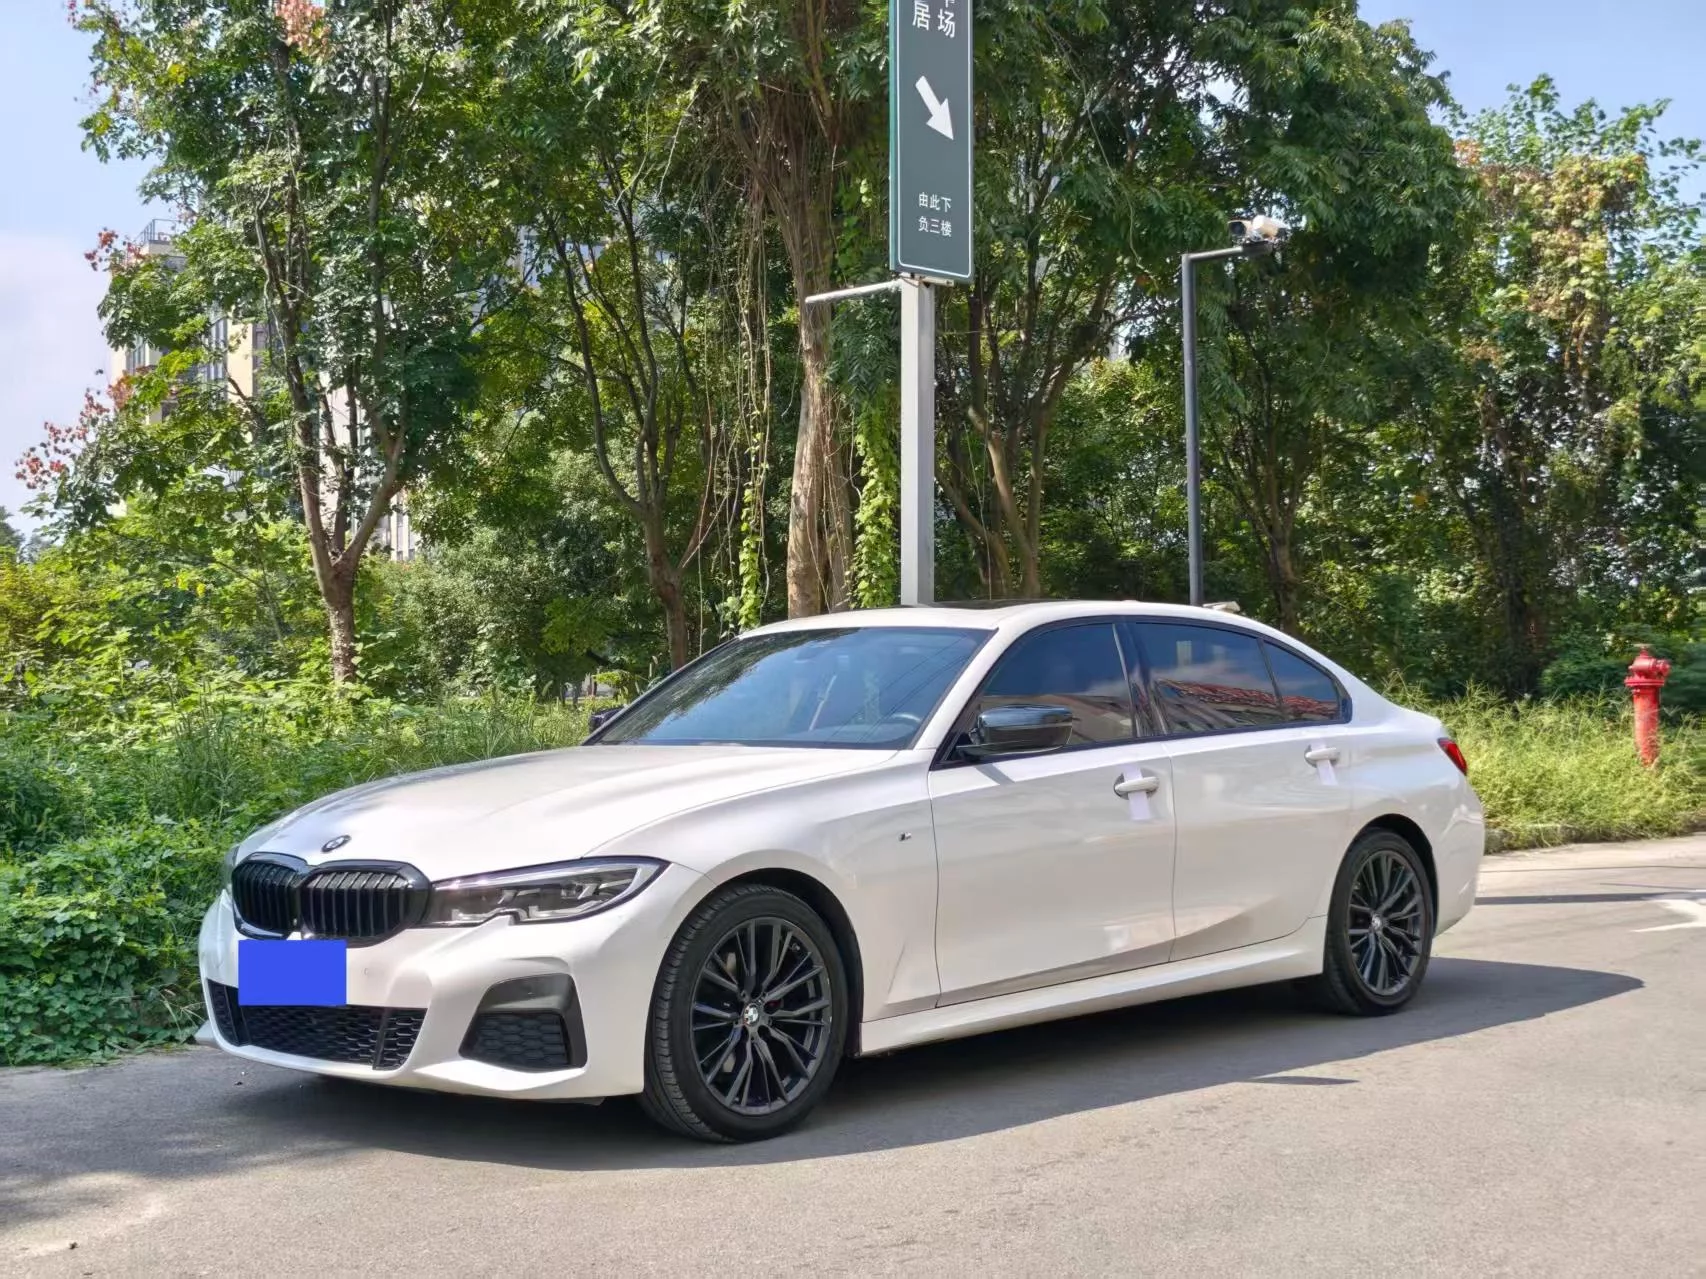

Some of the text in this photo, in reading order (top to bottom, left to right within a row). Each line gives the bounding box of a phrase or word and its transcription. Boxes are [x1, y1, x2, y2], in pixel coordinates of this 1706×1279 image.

[912, 0, 931, 31] 居
[937, 0, 955, 38] 场
[918, 191, 952, 212] 由此下
[918, 215, 952, 237] 负三楼
